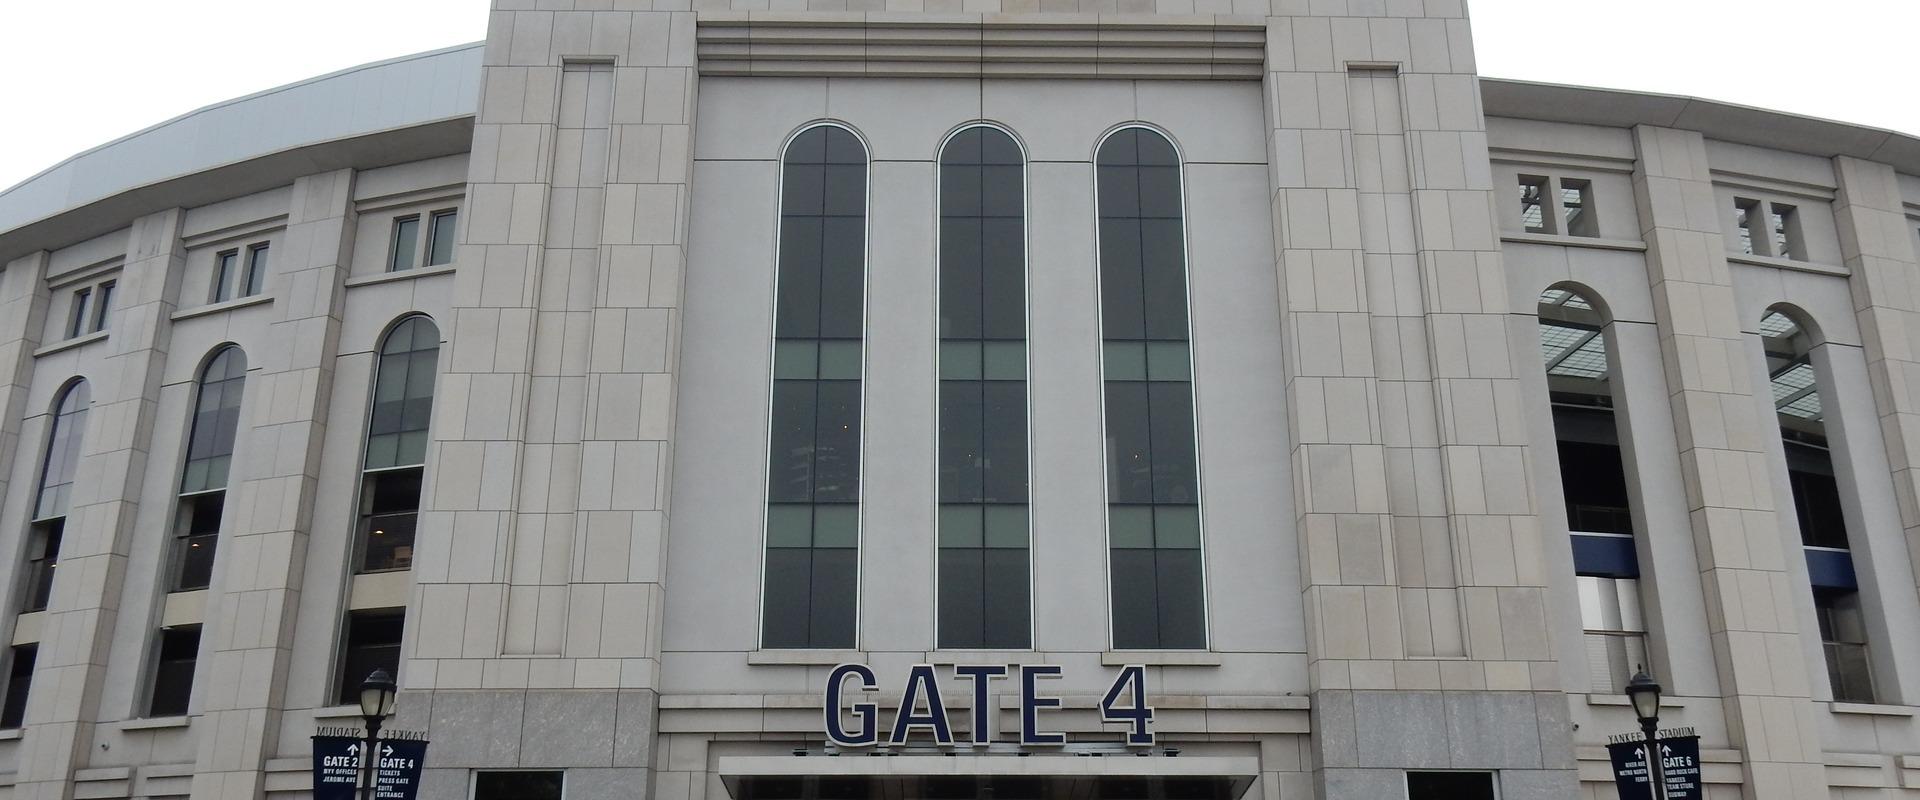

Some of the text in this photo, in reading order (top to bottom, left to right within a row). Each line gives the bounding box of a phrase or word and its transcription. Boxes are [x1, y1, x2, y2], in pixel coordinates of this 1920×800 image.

[823, 663, 1155, 747] GATE 4
[1659, 727, 1695, 738] STADIUM
[324, 756, 358, 767] GATE 2
[380, 758, 414, 769] GATE 4
[1663, 756, 1692, 768] GATE 6
